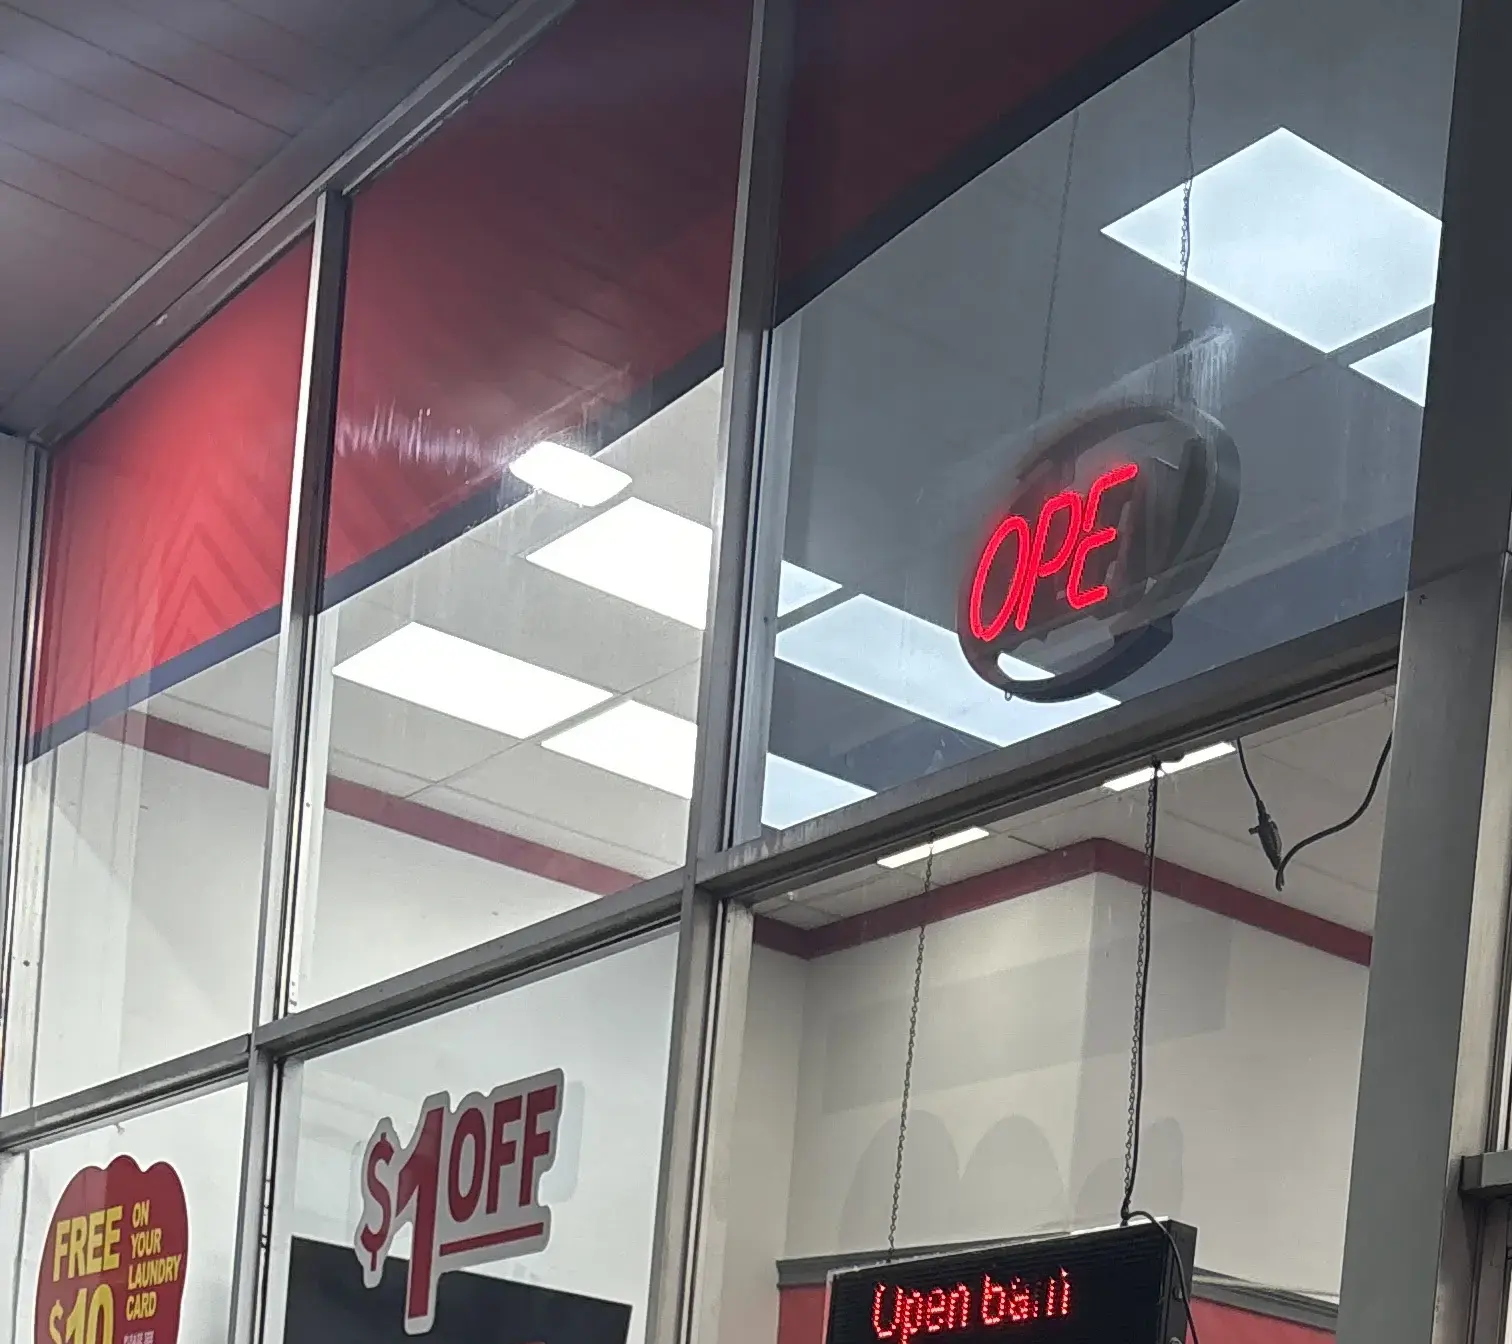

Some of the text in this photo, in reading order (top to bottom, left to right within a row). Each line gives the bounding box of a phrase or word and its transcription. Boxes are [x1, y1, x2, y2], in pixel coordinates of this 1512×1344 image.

[132, 1199, 151, 1228] ON
[360, 1085, 558, 1319] $1 OFF
[52, 1205, 124, 1283] FREE
[130, 1228, 162, 1259] YOUR
[127, 1254, 182, 1291] LAUNDRY
[125, 1291, 157, 1321] CARD
